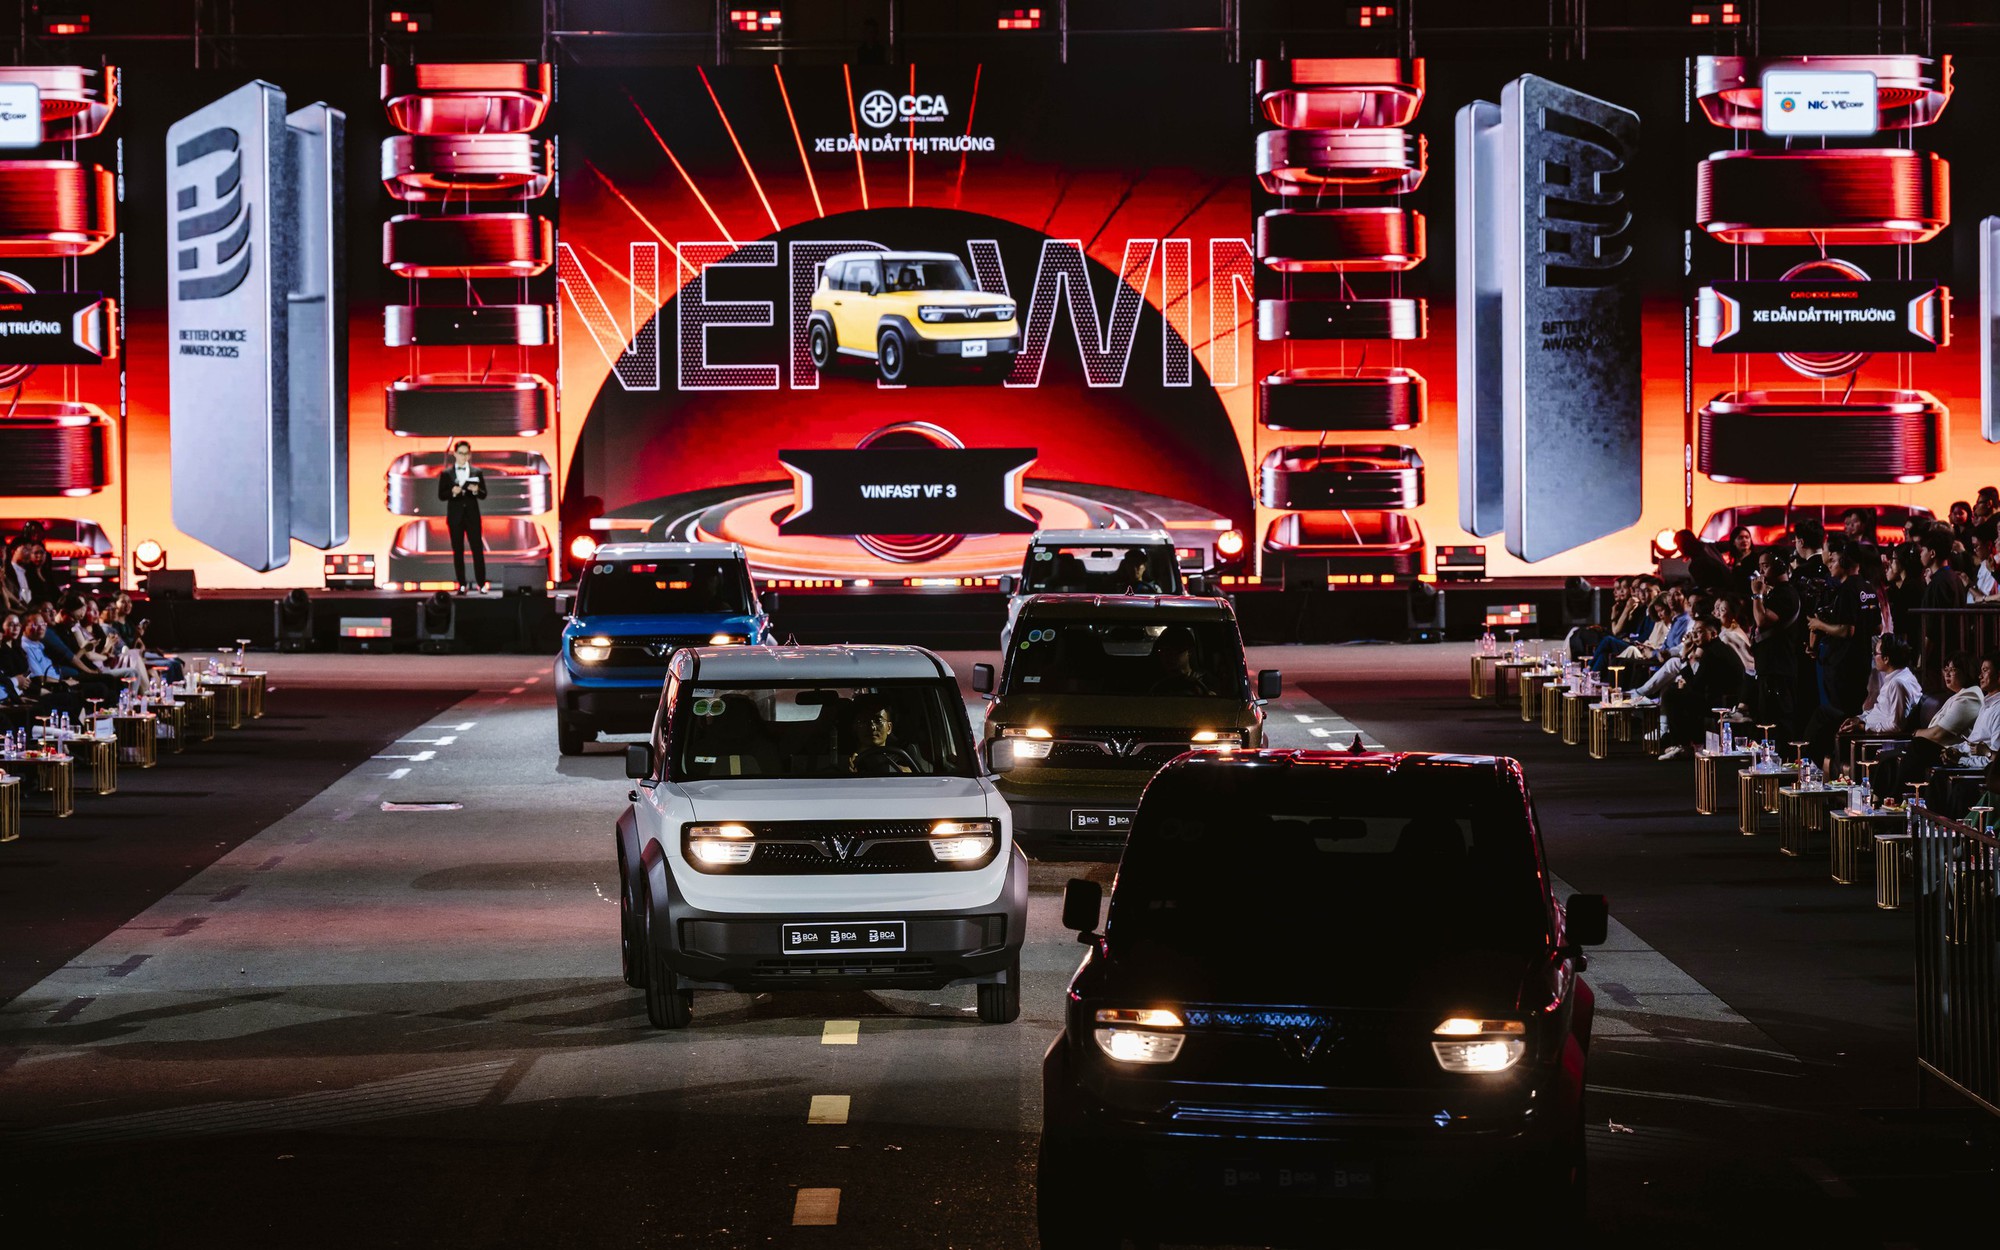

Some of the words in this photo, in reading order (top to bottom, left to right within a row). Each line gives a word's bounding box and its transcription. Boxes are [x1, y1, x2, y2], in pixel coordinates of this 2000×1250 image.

[898, 94, 949, 115] CCA
[815, 138, 835, 152] XE
[903, 138, 928, 154] THỊ
[930, 134, 995, 152] TRƯỜNG
[1753, 309, 1769, 322] XE
[1823, 309, 1842, 324] THỊ
[1843, 307, 1896, 322] TRƯỜNG
[8, 320, 61, 334] TRƯỜNG
[179, 330, 209, 341] BETTER
[211, 329, 247, 342] CHOICE
[179, 344, 215, 357] AWARDS
[216, 346, 239, 358] 2025
[860, 484, 921, 499] VINFAST
[923, 484, 943, 498] VF
[946, 484, 957, 498] 3
